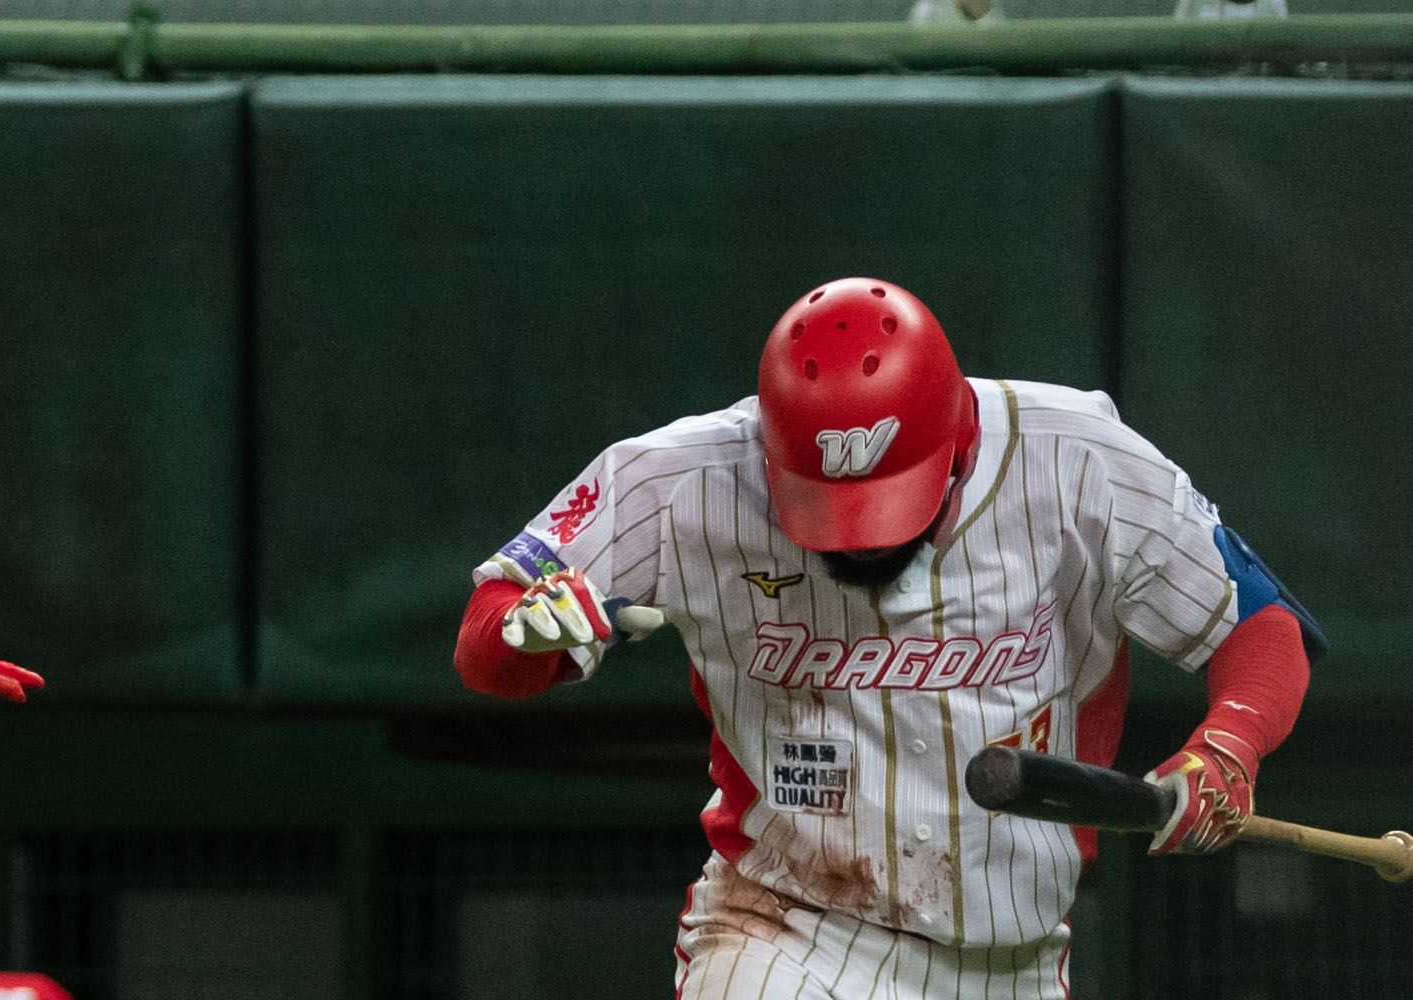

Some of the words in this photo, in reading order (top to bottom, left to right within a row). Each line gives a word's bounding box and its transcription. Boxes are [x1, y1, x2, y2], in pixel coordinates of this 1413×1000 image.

[816, 416, 900, 478] W
[748, 600, 1058, 691] DRAGONS
[773, 765, 816, 786] HIGH
[775, 787, 846, 809] QUALITY
